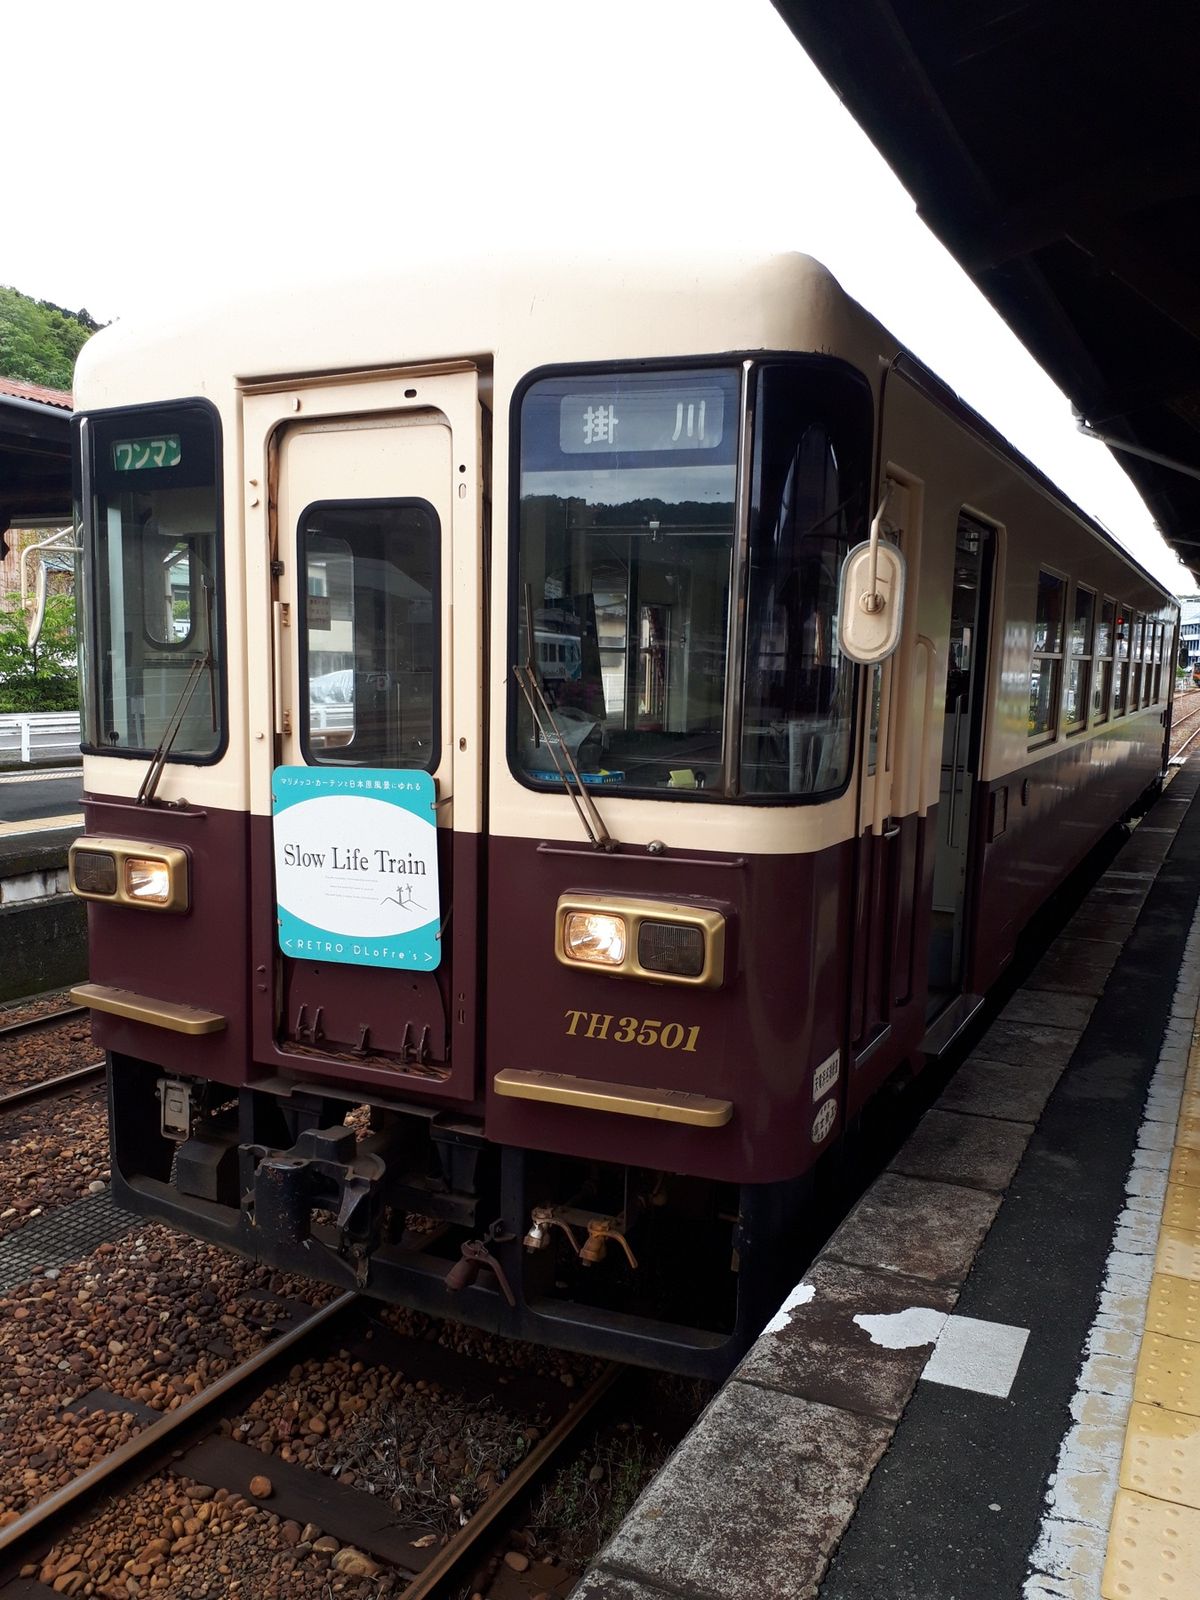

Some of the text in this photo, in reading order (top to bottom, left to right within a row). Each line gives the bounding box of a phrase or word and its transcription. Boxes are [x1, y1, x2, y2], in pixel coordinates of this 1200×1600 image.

[116, 440, 181, 470] ワンマン
[283, 843, 427, 875] Slow Life Train
